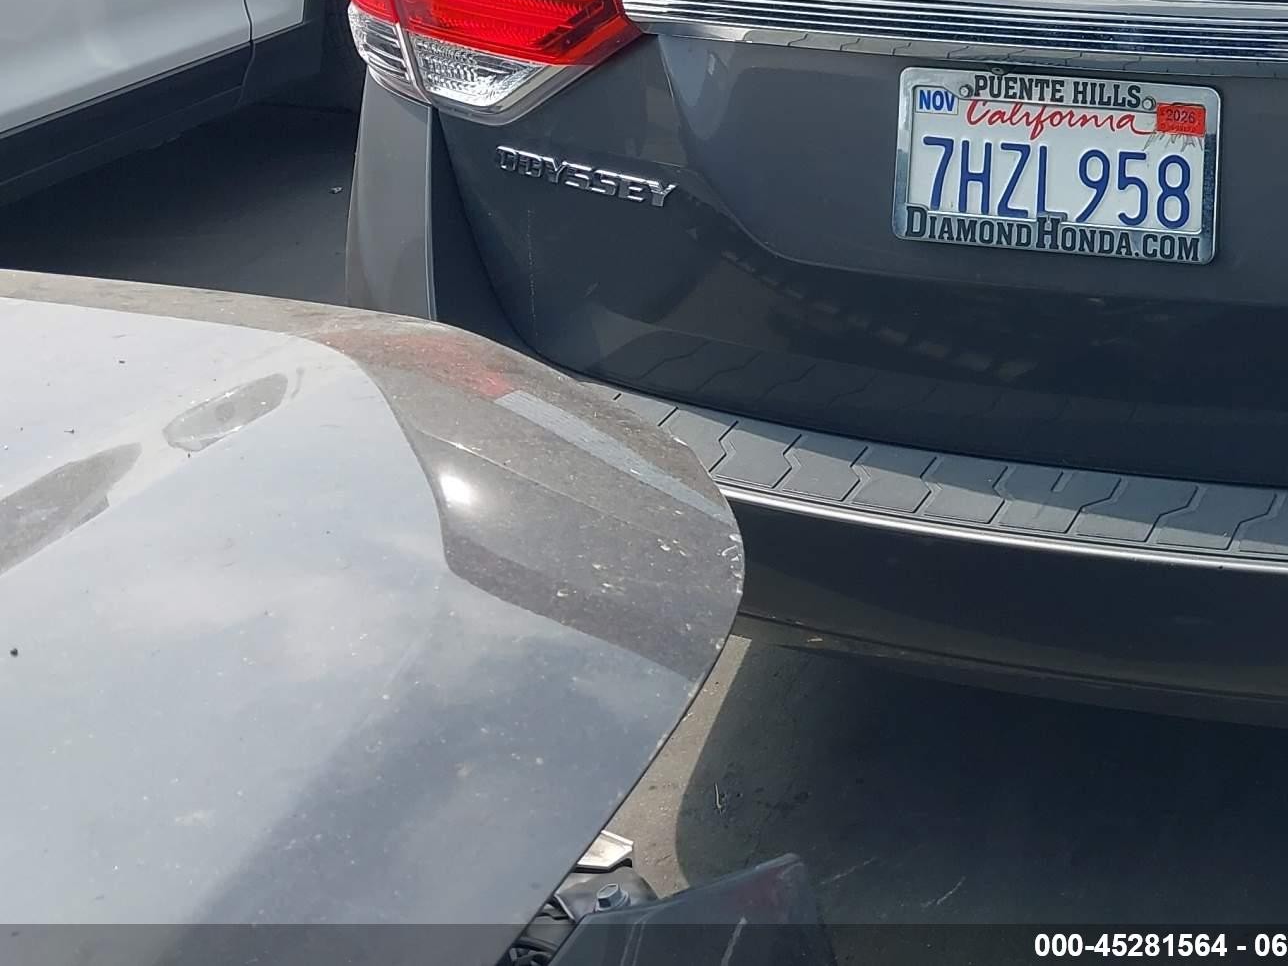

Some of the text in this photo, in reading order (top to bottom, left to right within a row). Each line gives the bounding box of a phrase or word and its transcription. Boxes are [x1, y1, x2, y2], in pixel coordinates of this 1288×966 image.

[918, 89, 955, 112] NOV
[974, 74, 1141, 107] PUENTE HILLS
[966, 99, 1158, 140] California
[1165, 108, 1196, 124] 2026
[496, 145, 679, 207] ODYSSEY
[922, 135, 1191, 229] 7HZL958
